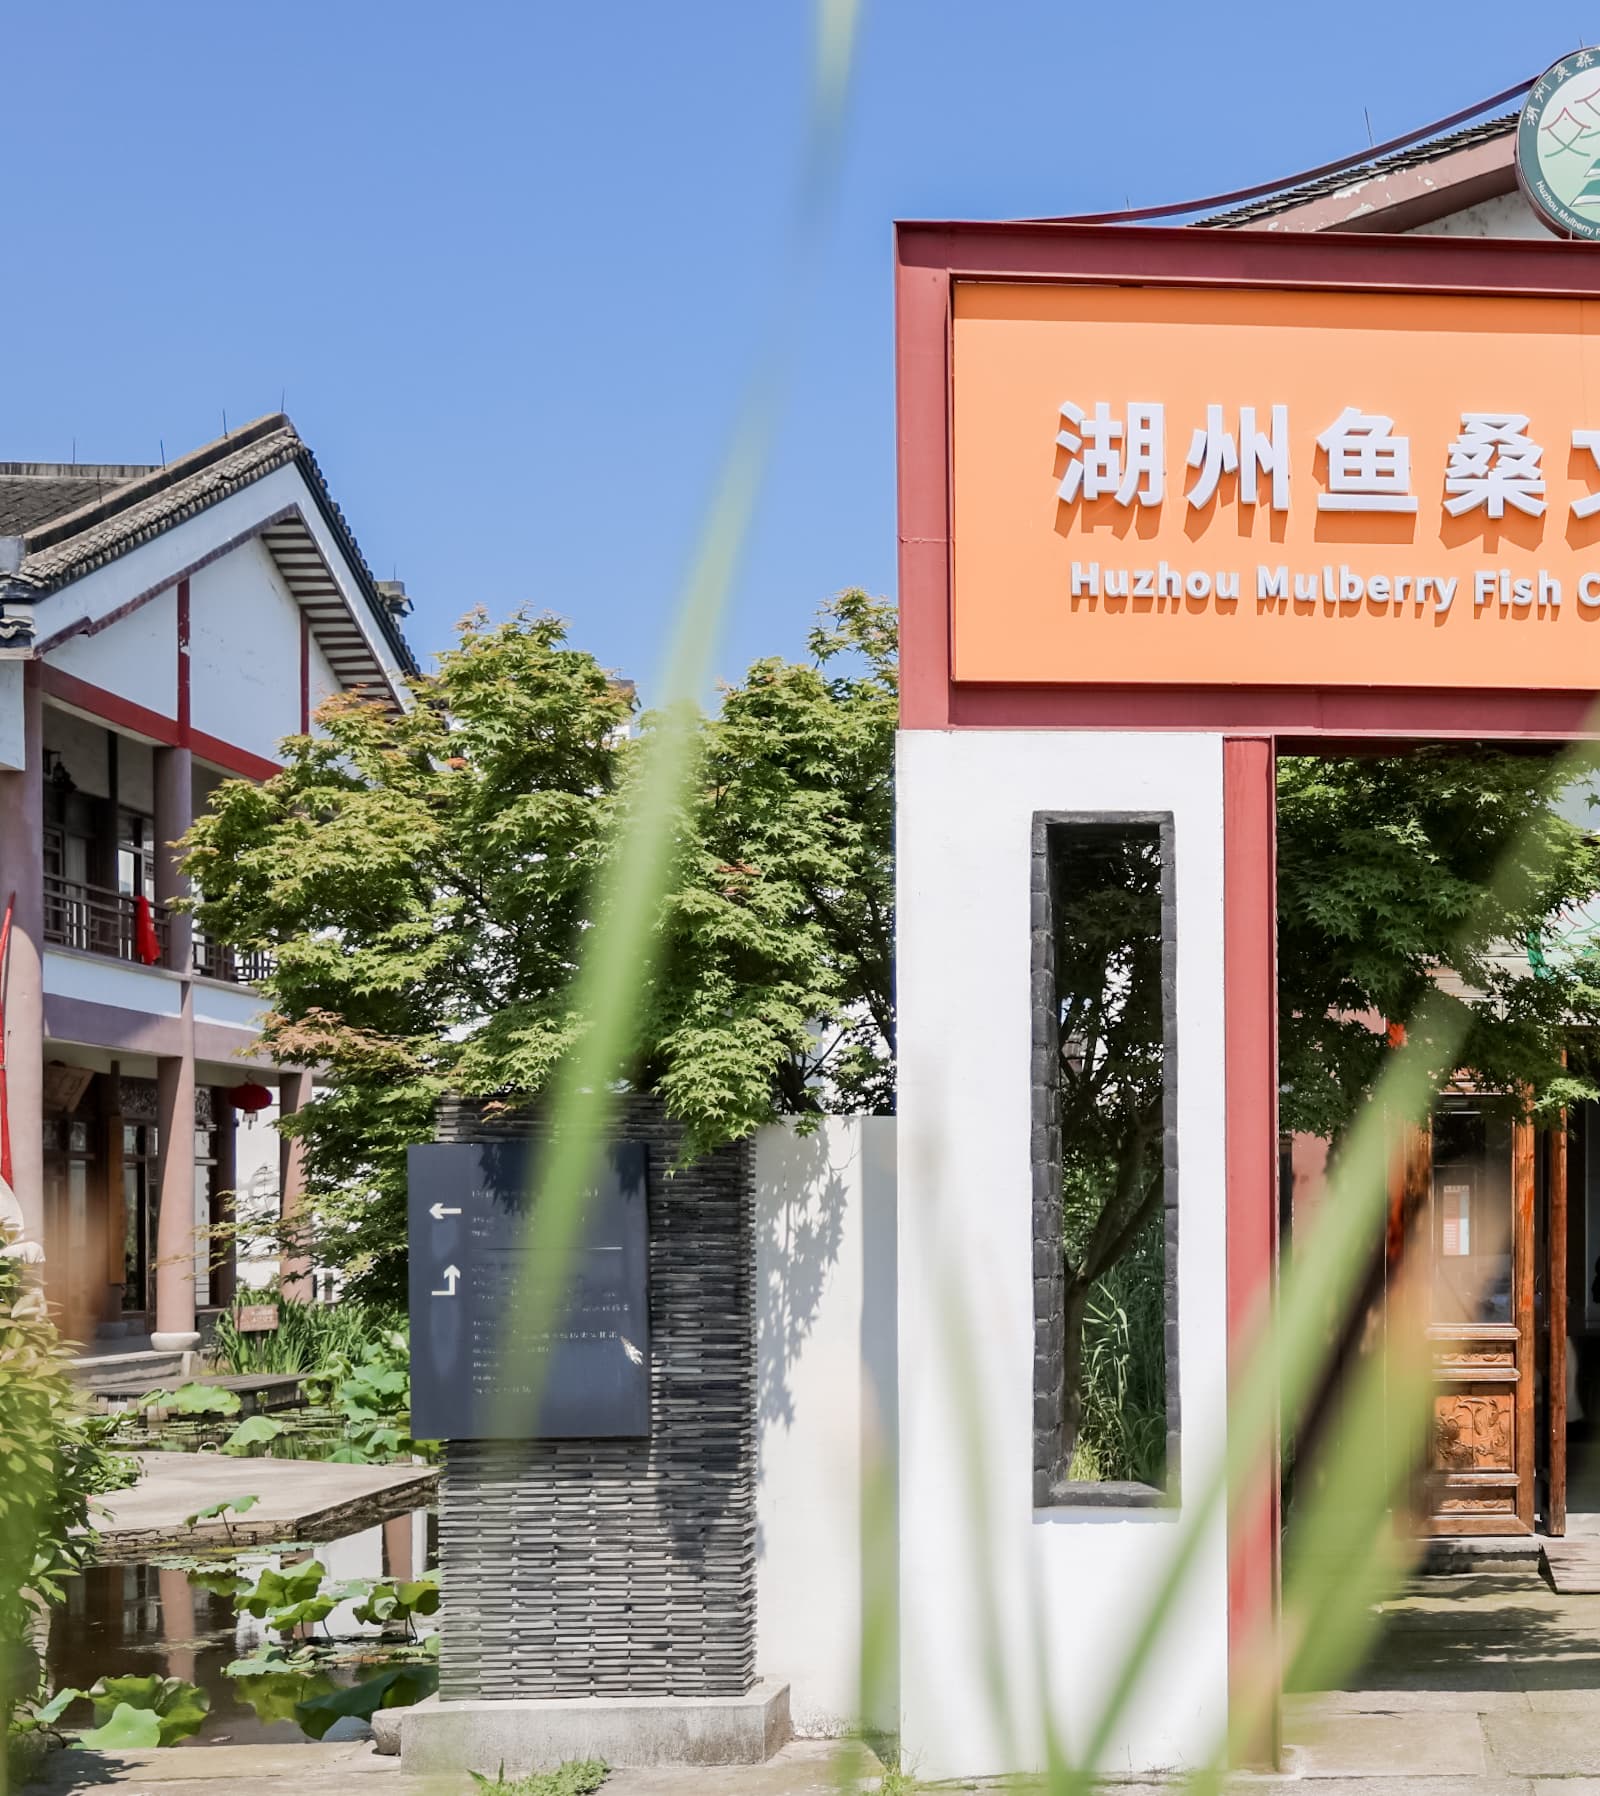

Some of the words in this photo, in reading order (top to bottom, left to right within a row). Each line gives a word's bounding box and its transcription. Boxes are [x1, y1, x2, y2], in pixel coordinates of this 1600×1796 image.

[1536, 180, 1559, 212] Huzhou
[1558, 208, 1593, 235] Mulberry
[1071, 561, 1239, 600] Huzhou
[1257, 565, 1458, 612] Mulberry
[1474, 569, 1561, 607] Fish
